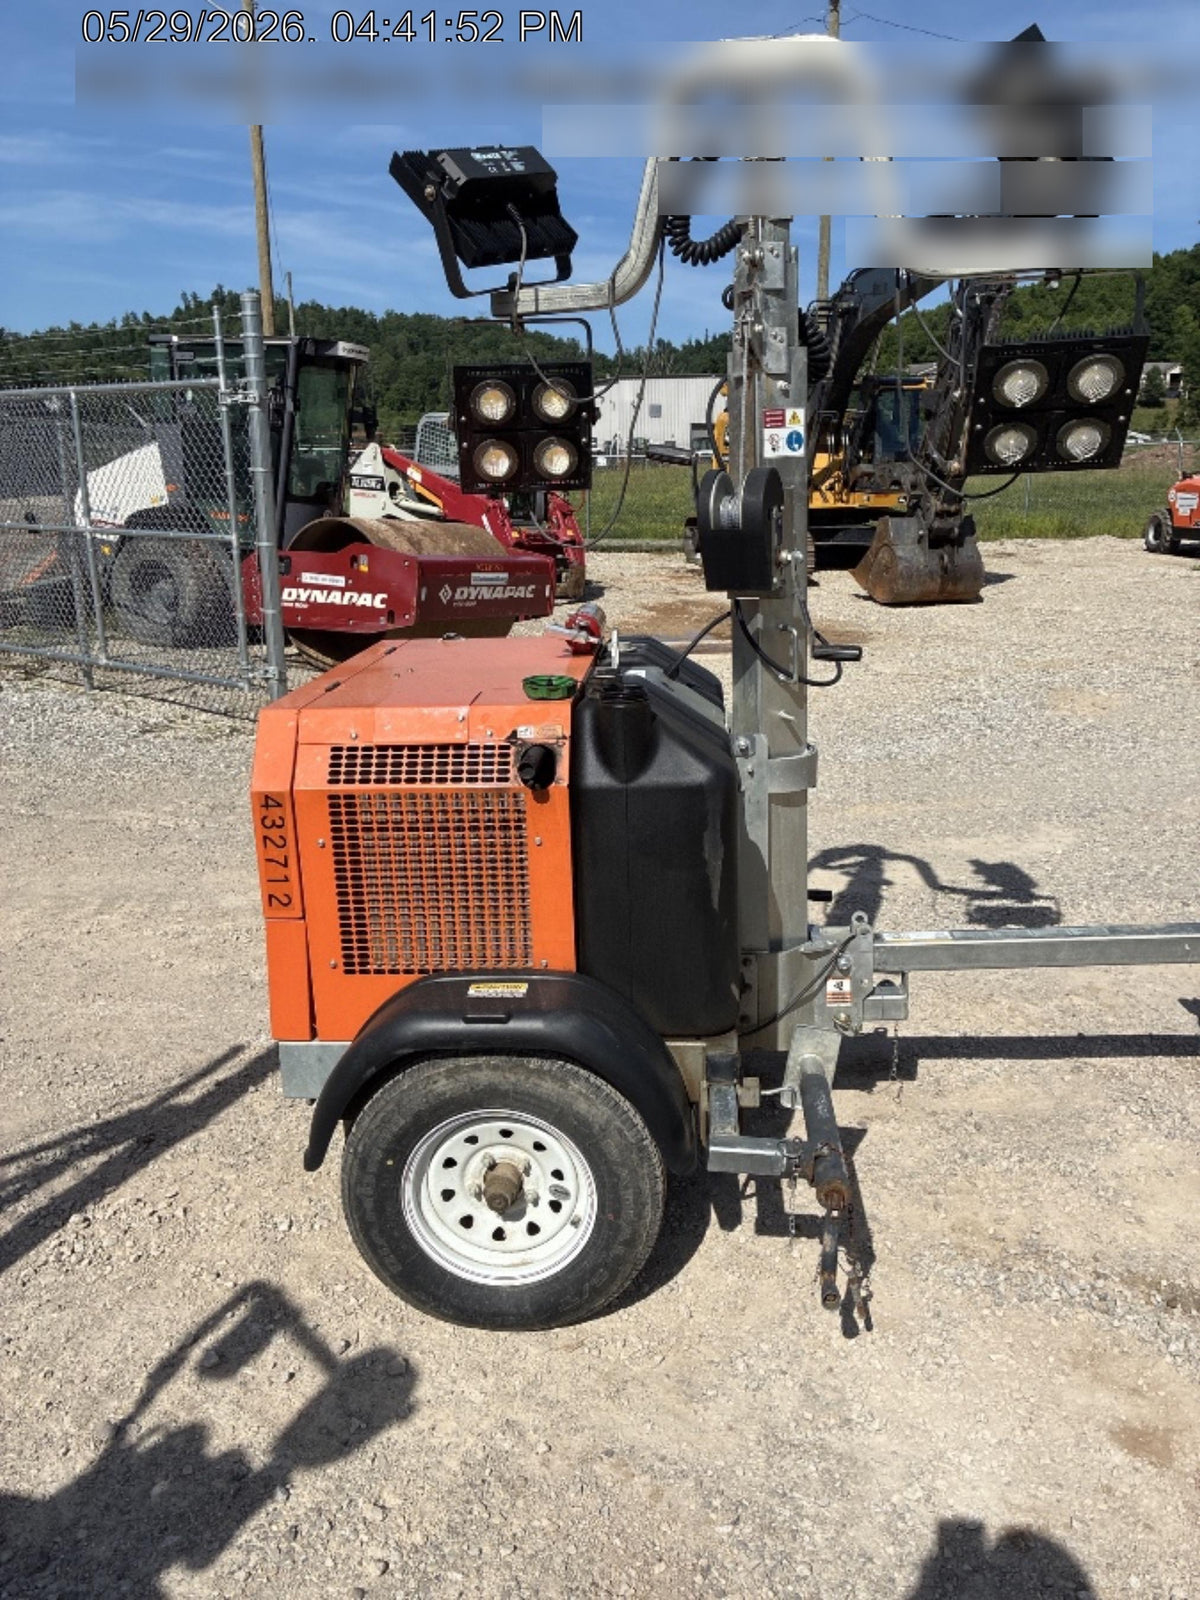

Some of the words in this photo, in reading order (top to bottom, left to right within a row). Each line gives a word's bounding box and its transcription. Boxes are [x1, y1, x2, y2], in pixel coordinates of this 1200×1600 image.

[281, 587, 389, 609] DYNAPAC
[454, 585, 536, 600] DYNAPAC
[260, 794, 292, 908] 432712
